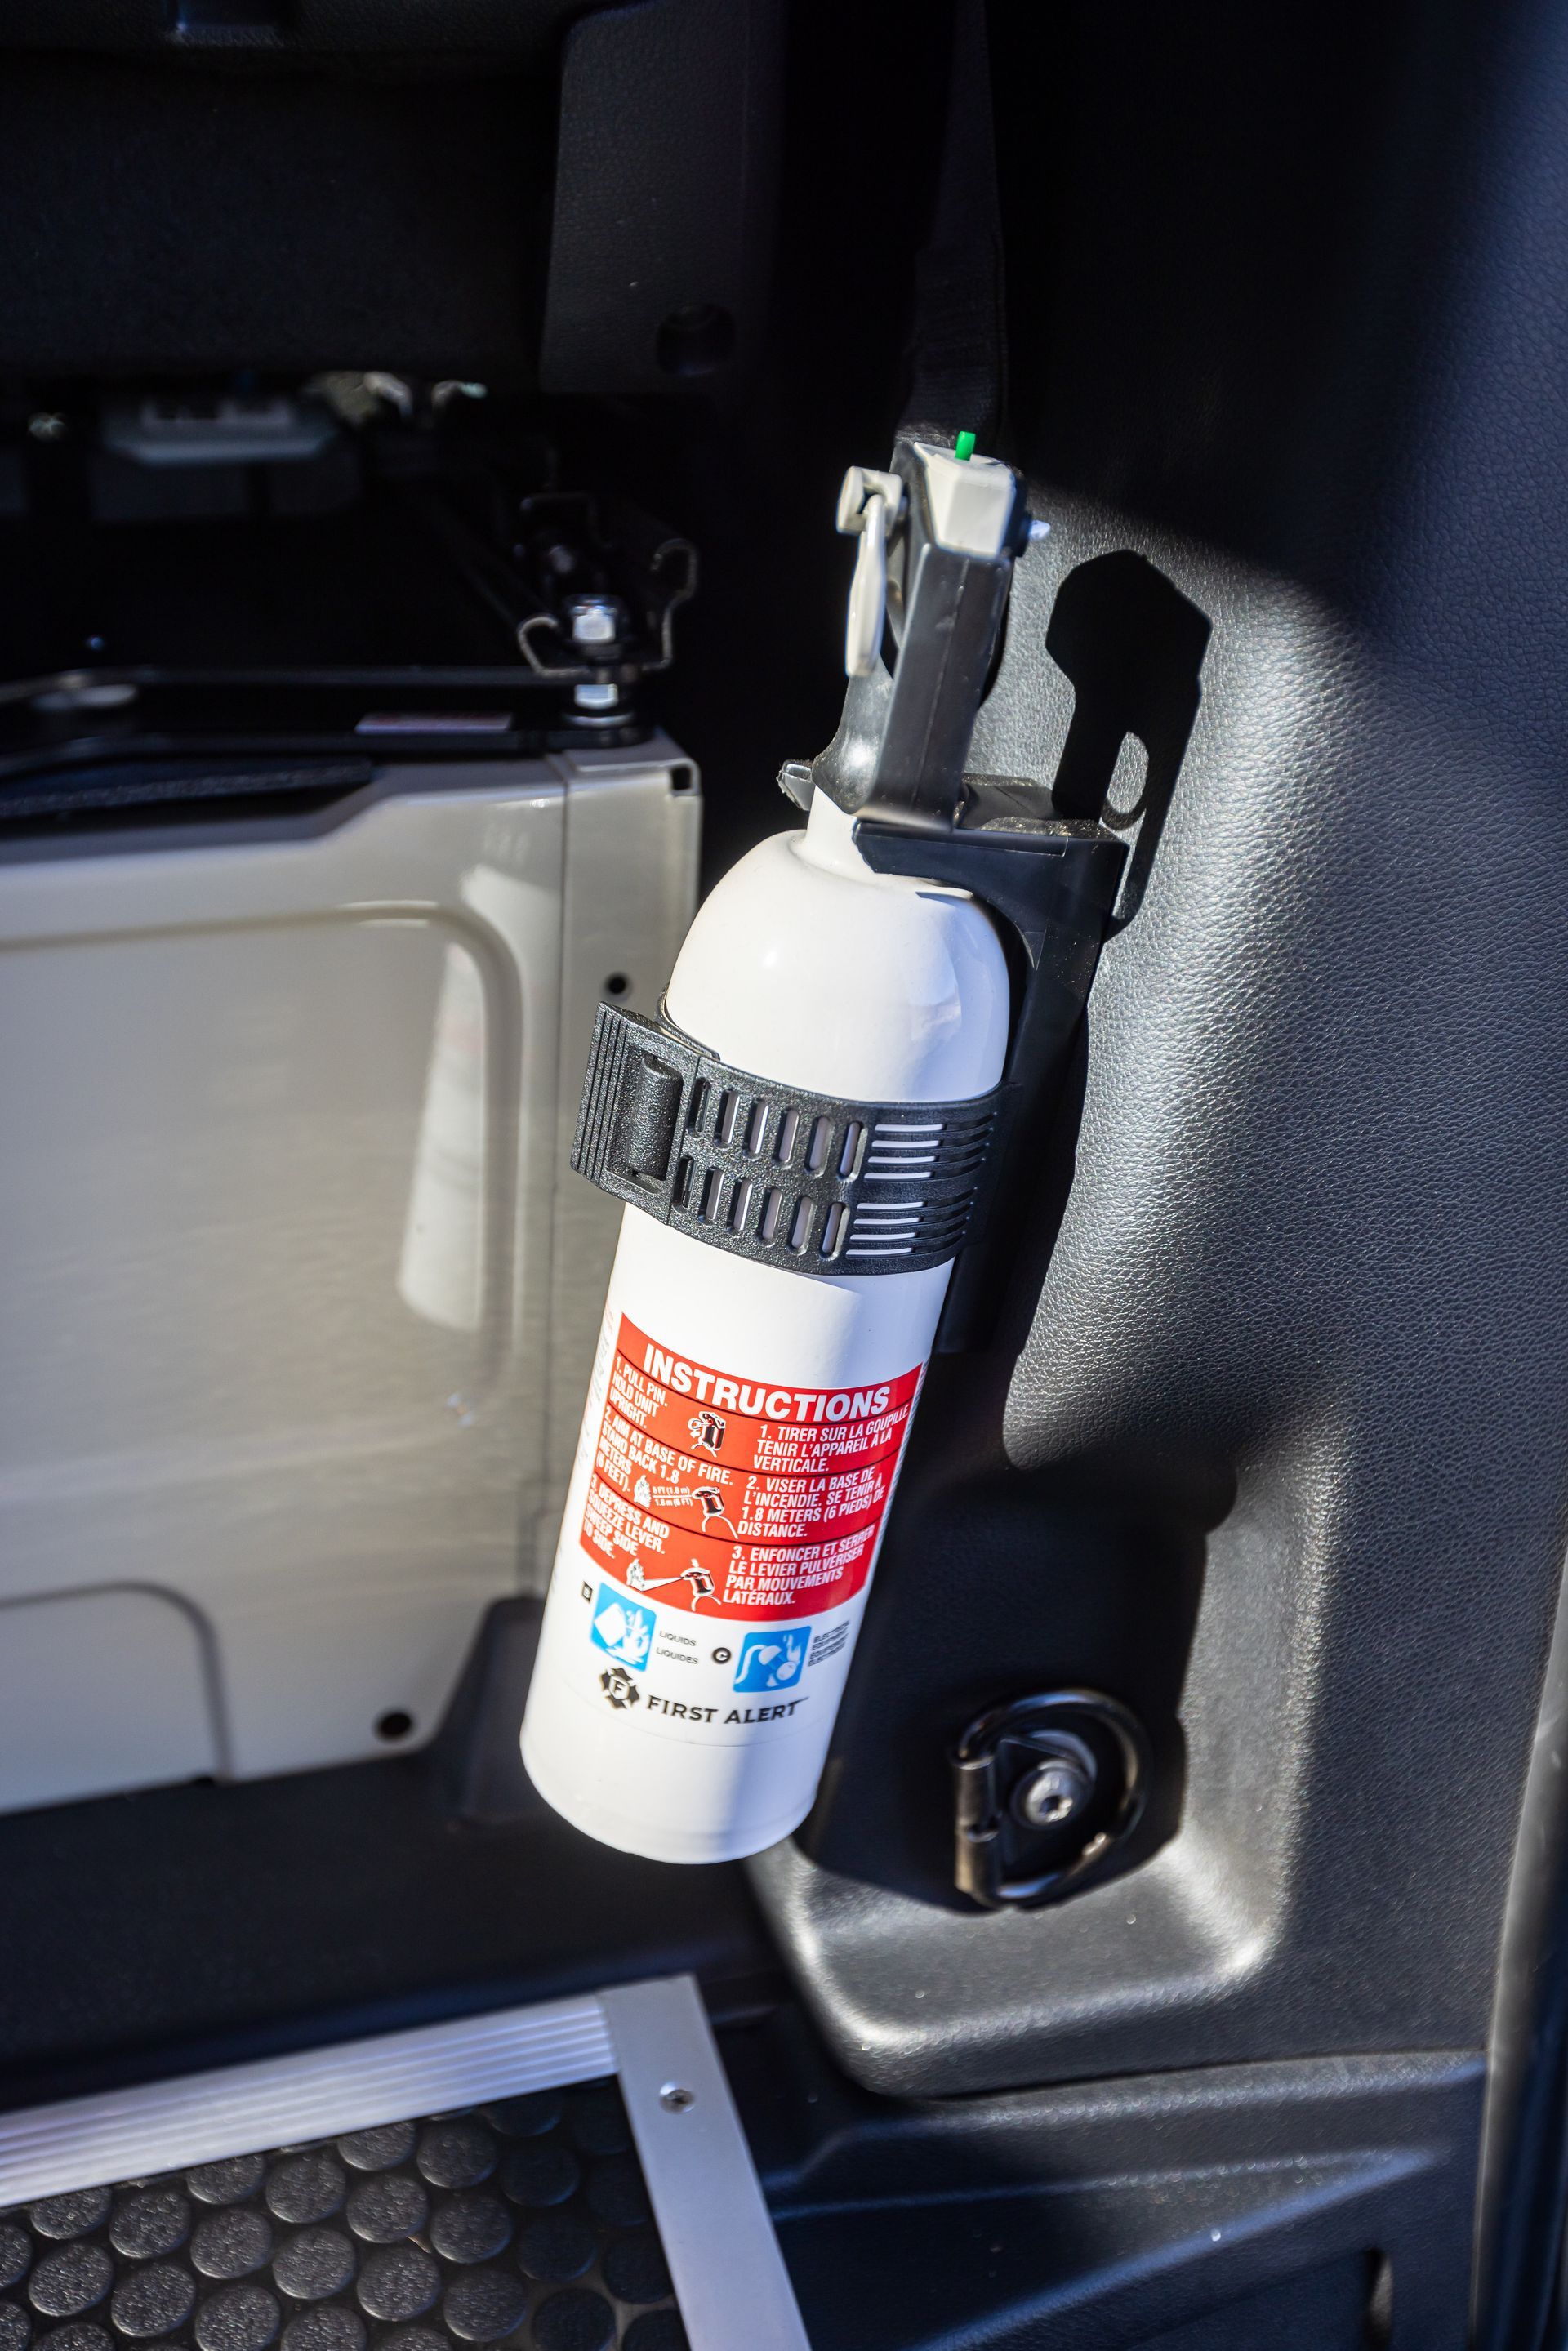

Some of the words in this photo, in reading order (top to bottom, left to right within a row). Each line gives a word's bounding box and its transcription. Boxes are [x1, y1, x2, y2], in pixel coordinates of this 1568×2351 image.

[612, 1370, 634, 1401] HOLD
[634, 1390, 659, 1417] UNIT
[617, 1356, 622, 1374] 1.
[623, 1364, 644, 1392] PULL
[646, 1381, 668, 1407] PIN.
[644, 1343, 890, 1422] INSTRUCTIONS
[610, 1386, 647, 1428] UPRIGHT.
[760, 1424, 772, 1439] 1.
[777, 1426, 817, 1442] TIRER
[819, 1425, 847, 1441] SUR
[849, 1422, 863, 1440] LA
[866, 1403, 910, 1436] GOUPILLE
[599, 1436, 633, 1474] METERS
[602, 1422, 628, 1453] STAND
[628, 1445, 657, 1475] BACK
[660, 1464, 679, 1484] 1.8
[604, 1405, 612, 1423] 2.
[612, 1414, 630, 1437] AIM
[630, 1430, 644, 1447] AT
[644, 1437, 676, 1466] BASE
[678, 1456, 697, 1474] OF
[698, 1463, 733, 1486] FIRE.
[757, 1439, 798, 1458] TENIR
[800, 1435, 868, 1458] L'APPAREIL
[880, 1427, 893, 1445] LA
[604, 1457, 631, 1493] FEET).
[746, 1475, 760, 1489] 2.
[766, 1477, 806, 1493] VISER
[809, 1477, 826, 1493] LA
[828, 1472, 859, 1490] BASE
[860, 1467, 875, 1483] DE
[754, 1455, 830, 1473] VERTICALE.
[599, 1483, 642, 1525] DEPRESS
[643, 1516, 670, 1538] AND
[742, 1506, 764, 1521] 1.8
[823, 1506, 837, 1523] (6
[838, 1495, 872, 1517] PIEDS)
[872, 1485, 886, 1504] DE
[743, 1490, 822, 1508] L'INCENDIE.
[826, 1489, 844, 1506] SE
[844, 1481, 876, 1502] TENIR
[612, 1529, 638, 1556] SIDE
[625, 1521, 666, 1555] LEVER.
[732, 1545, 745, 1560] 3.
[750, 1546, 820, 1563] ENFONCER
[822, 1542, 838, 1557] ET
[838, 1524, 875, 1553] SERRER
[737, 1520, 808, 1538] DISTANCE.
[728, 1560, 747, 1575] LE
[749, 1561, 797, 1578] LEVIER
[800, 1544, 865, 1575] PULVÉRISER
[726, 1574, 755, 1590] PAR
[757, 1566, 844, 1592] MOUVEMENTS
[723, 1589, 796, 1605] LATÉRAUX.
[659, 1630, 697, 1647] LIQUIDS
[656, 1647, 699, 1665] LIQUIDES
[647, 1694, 718, 1723] FIRST
[724, 1696, 809, 1724] ALERT
